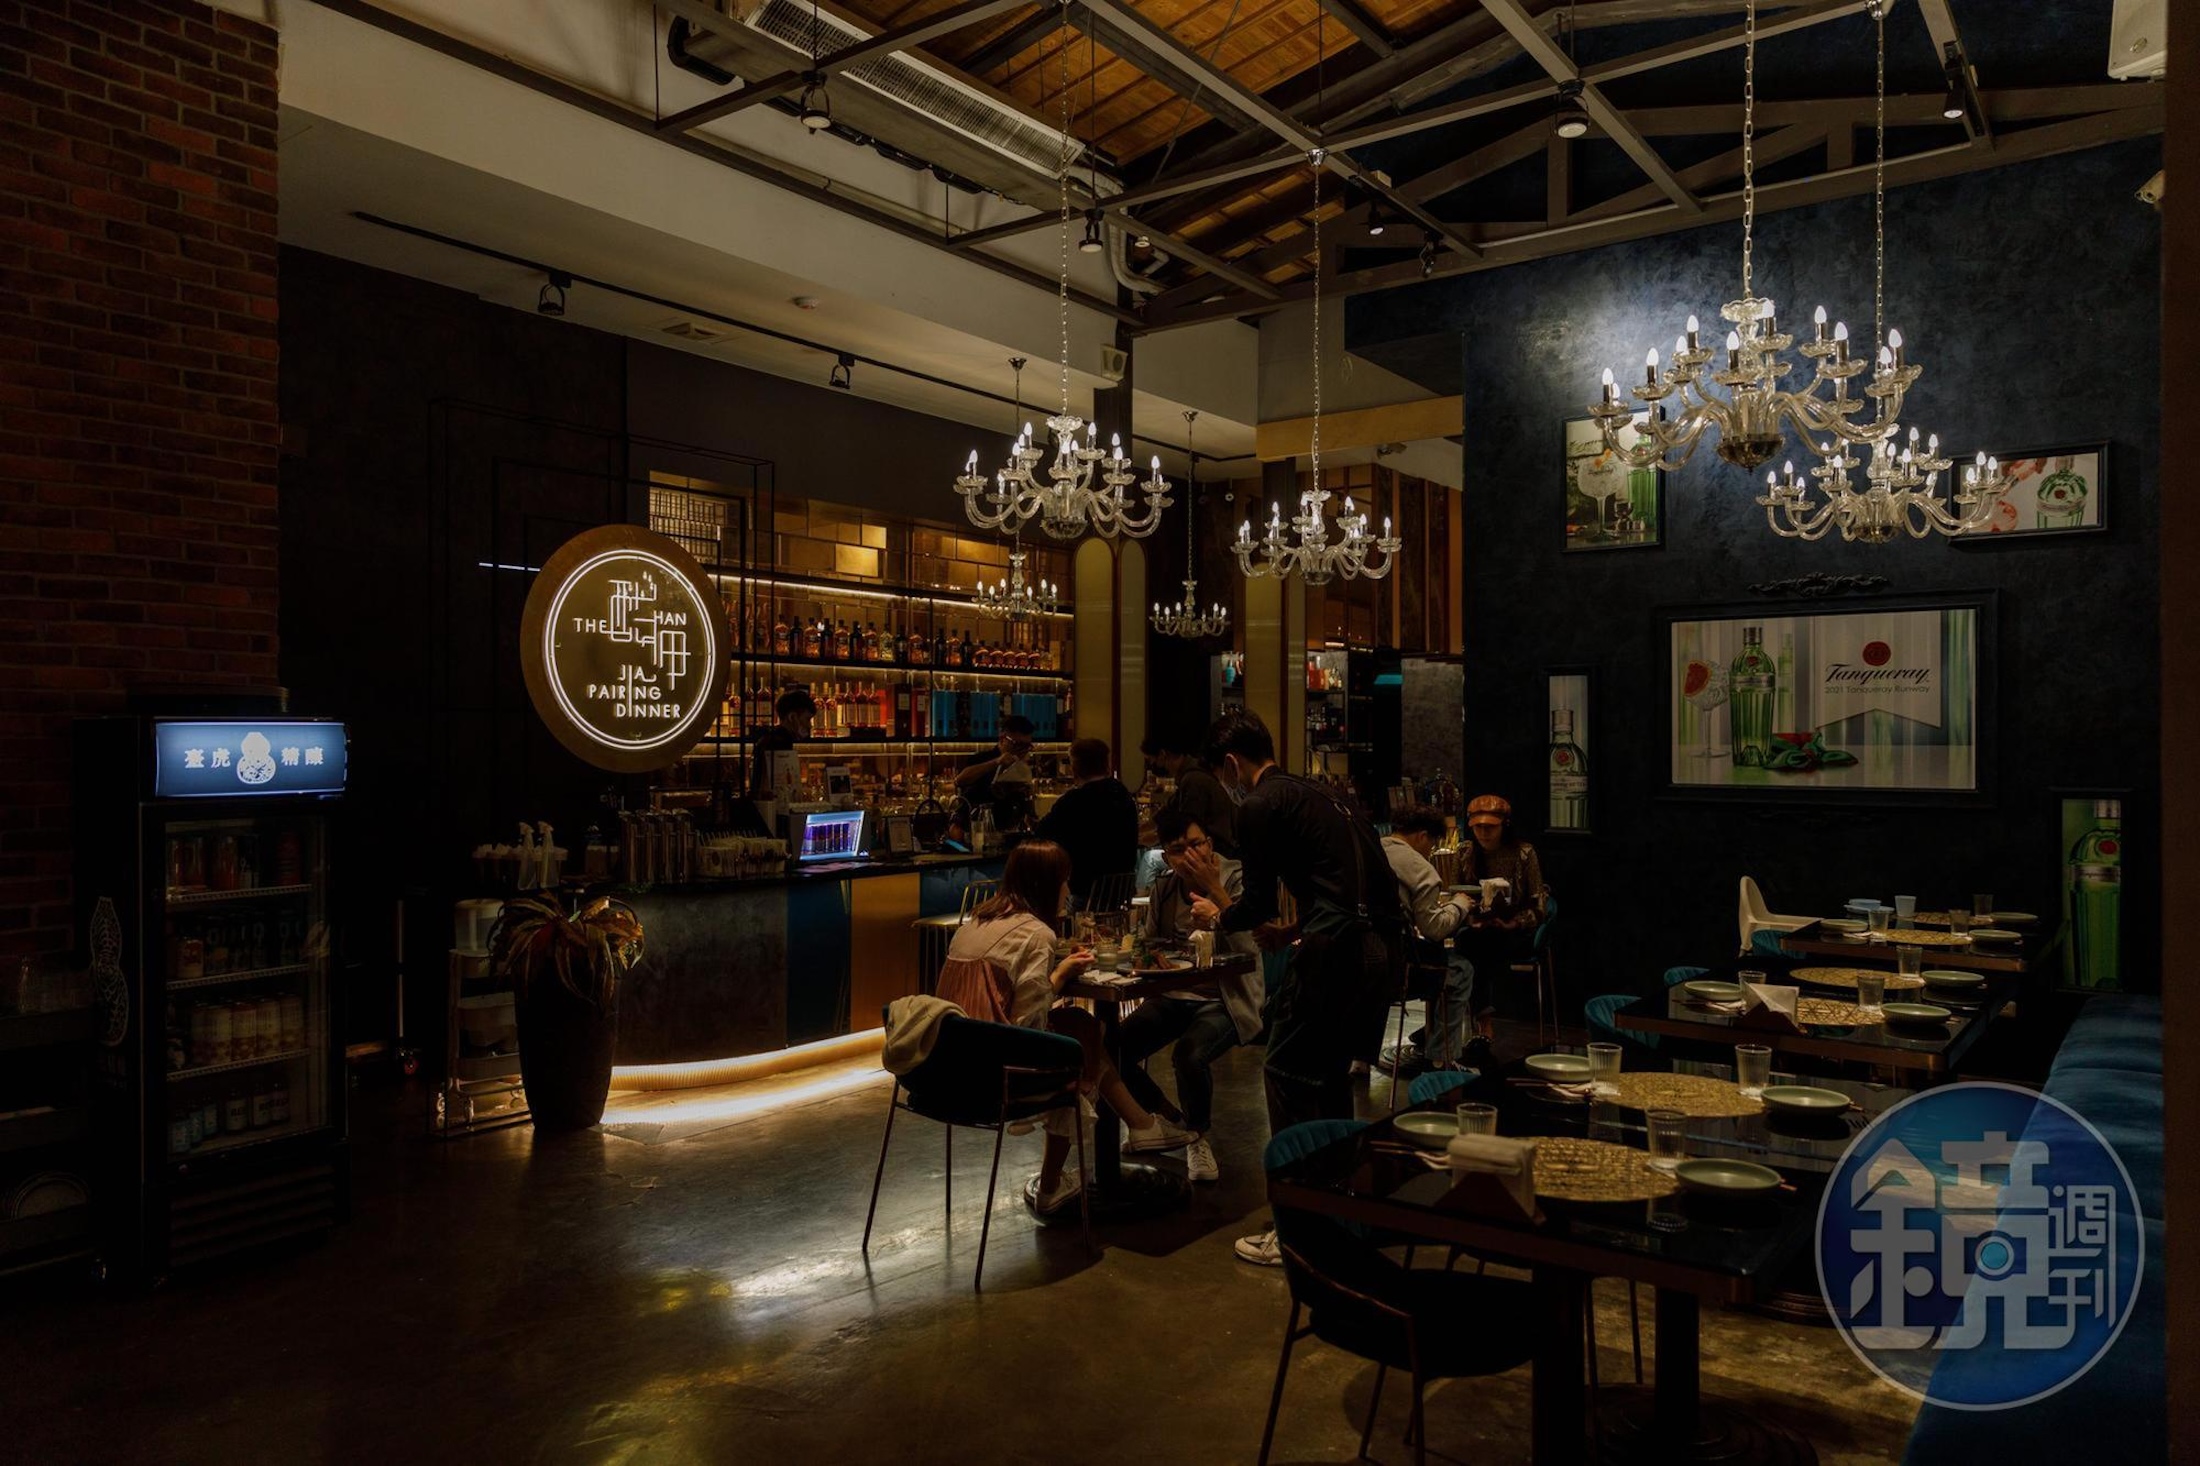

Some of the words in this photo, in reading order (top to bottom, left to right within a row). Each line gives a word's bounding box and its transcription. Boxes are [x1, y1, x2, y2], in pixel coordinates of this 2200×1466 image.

[573, 617, 608, 634] THE
[653, 610, 687, 626] HAN
[618, 664, 657, 682] JIA
[1826, 663, 1930, 685] Tanqueray
[588, 683, 662, 701] PAIRING
[1825, 686, 1844, 695] 2021
[1846, 685, 1893, 696] Tanqueray
[1894, 684, 1930, 695] Runway
[616, 703, 681, 719] DINNER
